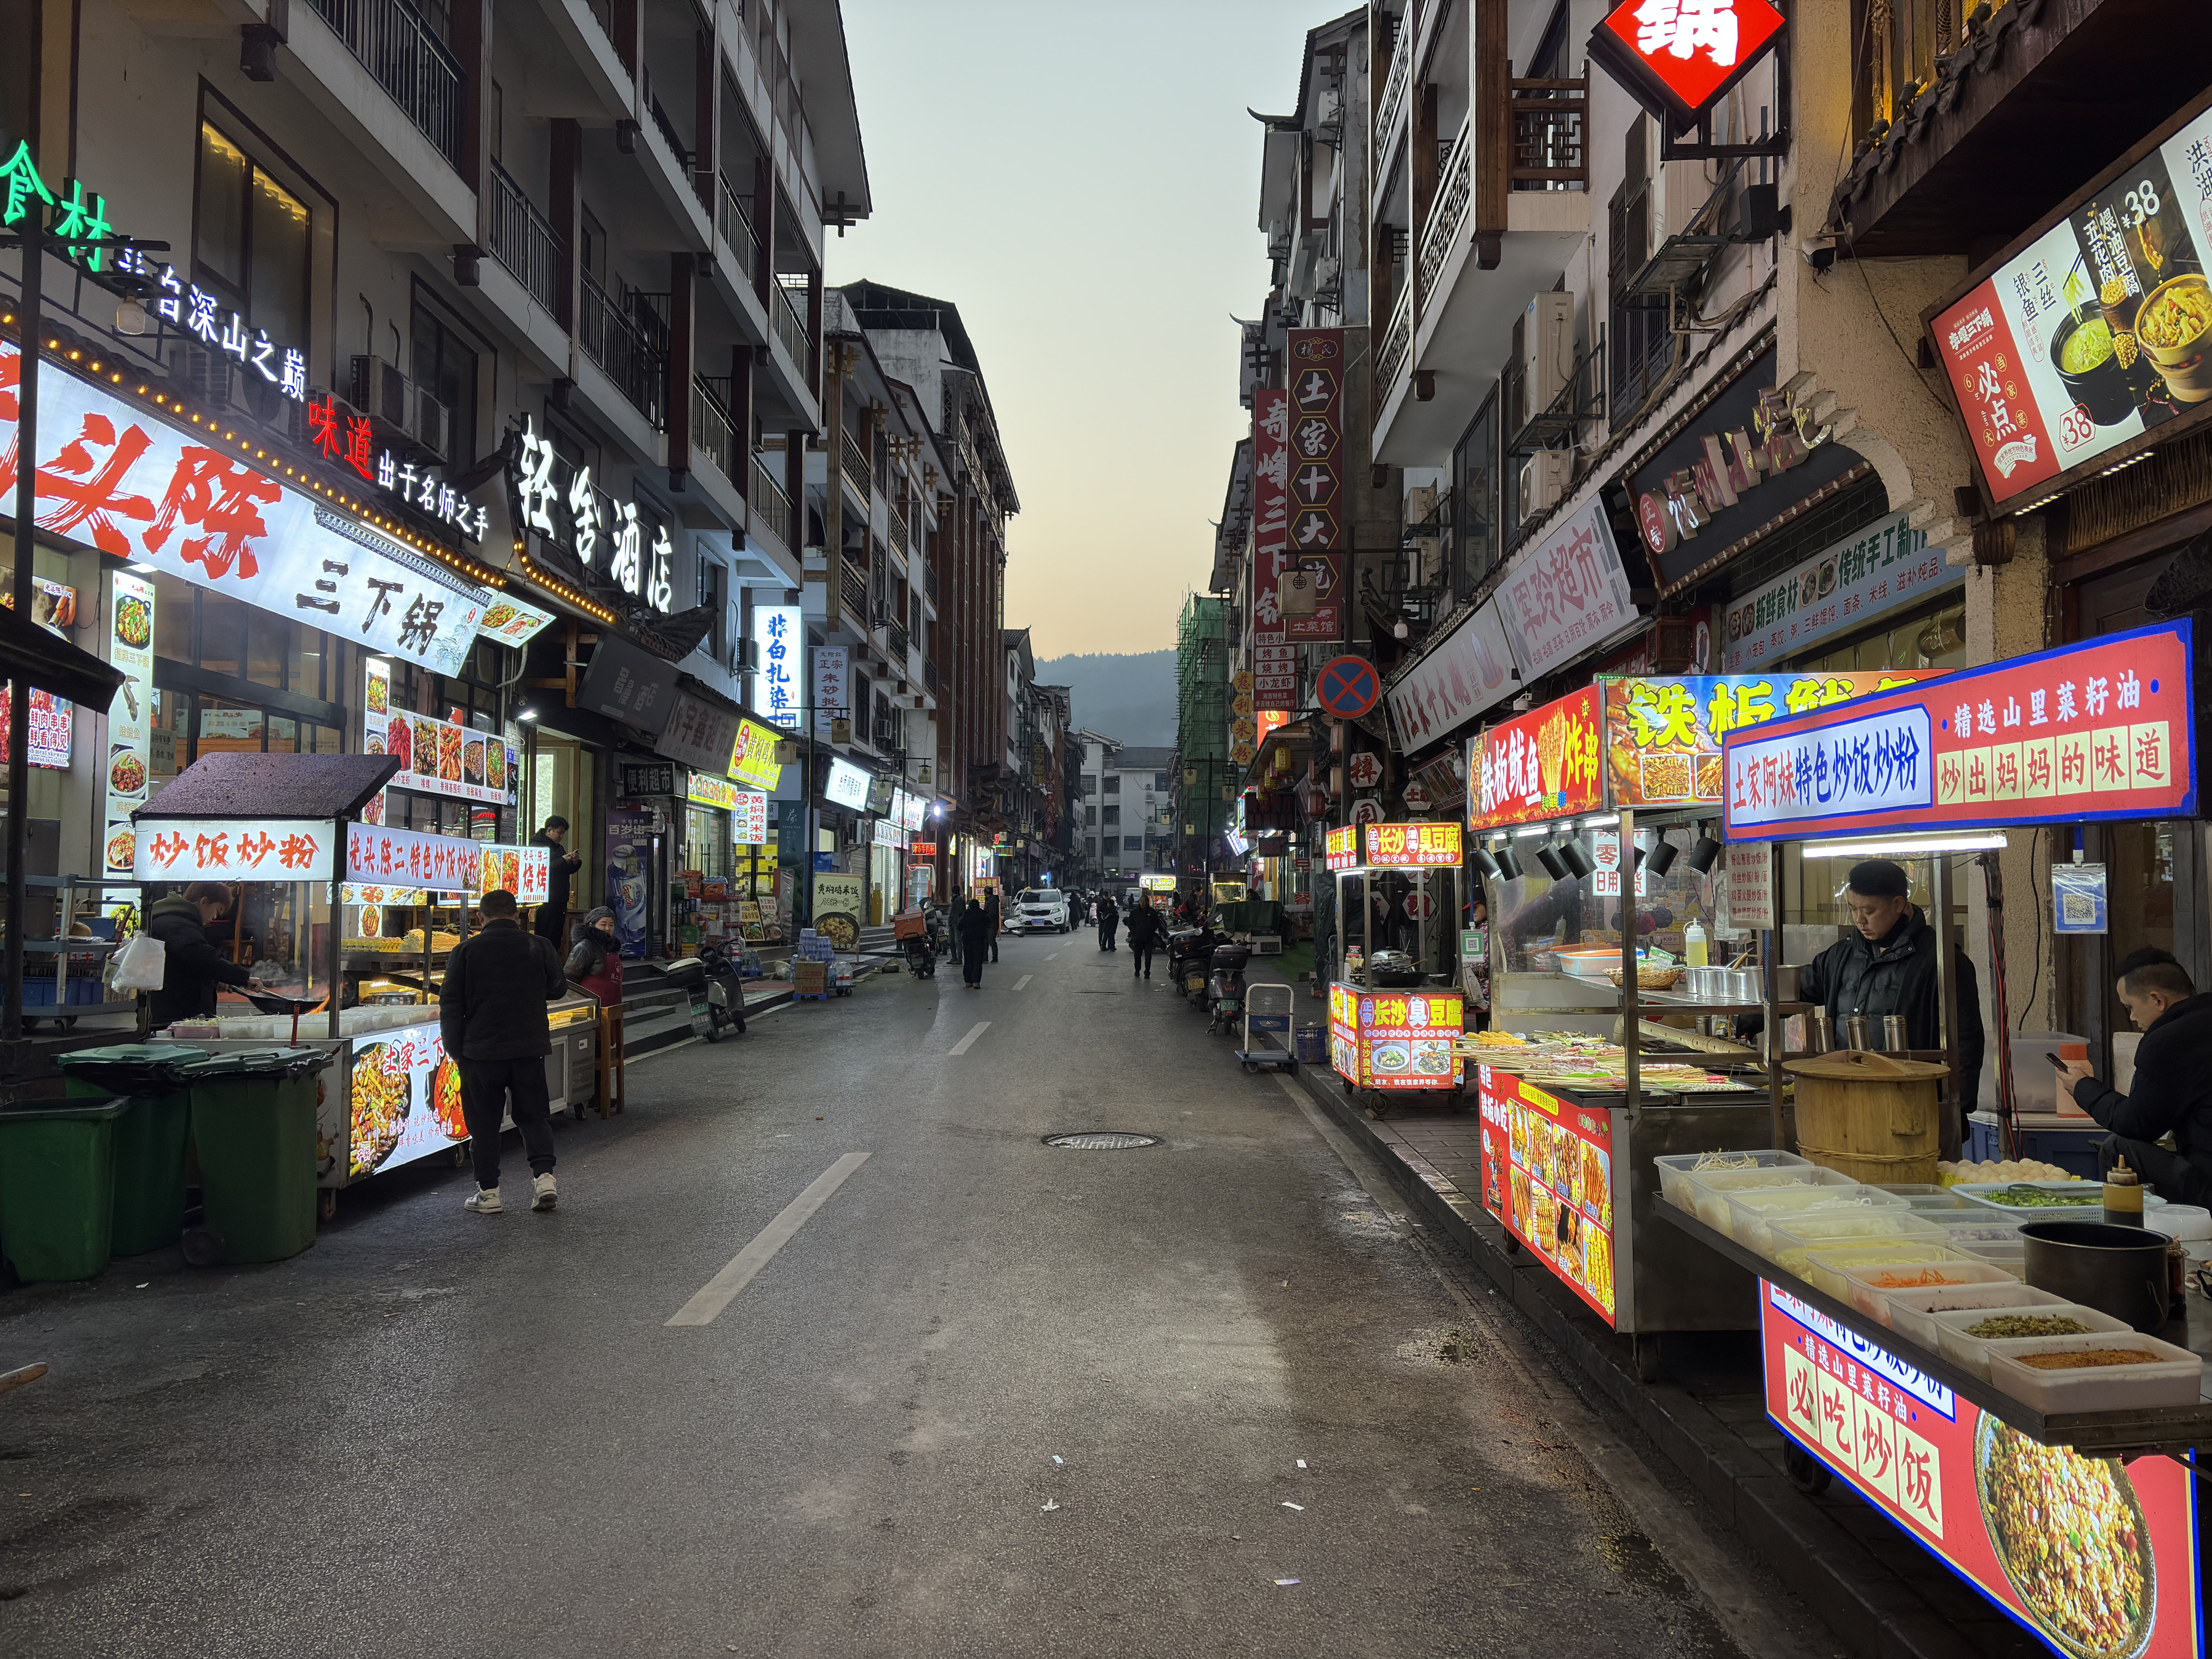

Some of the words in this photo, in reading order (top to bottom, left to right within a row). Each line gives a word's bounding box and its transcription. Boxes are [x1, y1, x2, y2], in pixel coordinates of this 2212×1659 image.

[2083, 220, 2115, 288] 五花肉
[2099, 207, 2140, 297] 煨油豆腐
[2013, 272, 2039, 322] 银鱼
[2032, 262, 2057, 311] 三丝
[0, 139, 112, 272] 食材
[309, 396, 373, 480] 味道
[378, 449, 489, 542] 出于名师之手
[1977, 361, 2017, 441] 必点
[0, 342, 282, 580] 头陈
[296, 559, 445, 656] 三下锅
[518, 414, 673, 613] 轻舍酒店
[1643, 500, 1663, 547] 正宗
[1564, 619, 1588, 644] 日用百货
[1585, 611, 1600, 631] 雨衣
[1599, 600, 1614, 622] 雨伞
[1756, 577, 1798, 631] 新鲜食材
[1258, 634, 1284, 644] 特色小
[1292, 622, 1334, 632] 土菜馆
[818, 660, 843, 669] 正宗
[1262, 648, 1288, 659] 烤鱼
[1262, 663, 1288, 674] 烧烤
[821, 674, 839, 719] 朱砂批发
[1259, 677, 1291, 688] 小龙虾
[29, 708, 69, 732] 鲜肉串串
[1234, 673, 1251, 761] 慈利米粉
[1954, 669, 2141, 738] 精选山里菜籽油
[29, 727, 69, 750] 鲜看得见
[119, 725, 140, 740] 娃娃鱼
[745, 732, 779, 769] 黄焖鸡米
[48, 750, 68, 759] skewers
[1481, 727, 1541, 813] 铁板鱿鱼
[1565, 713, 1599, 799] 炸串
[1734, 726, 1920, 812] 土家阿妹特色炒饭炒粉
[1941, 728, 2165, 800] 炒出妈妈的味道
[390, 774, 410, 786] 味小龙虾
[628, 768, 671, 792] 便利超市
[609, 825, 644, 834] 百岁山
[749, 796, 764, 842] 黄焖鸡米饭
[149, 831, 321, 871] 炒饭炒粉
[912, 843, 935, 854] 津市牛肉粉
[1370, 831, 1378, 851] 正宗
[1379, 827, 1405, 854] 长沙
[1419, 826, 1458, 854] 臭豆腐
[523, 863, 547, 893] 烧烤
[818, 884, 859, 895] 黄焖鸡米饭
[823, 898, 849, 907] 18元一份
[1363, 1001, 1372, 1023] 正宗
[1375, 999, 1406, 1026] 长沙
[1410, 999, 1427, 1026] 臭
[1429, 999, 1462, 1026] 豆腐
[383, 1036, 446, 1075] 土家三下
[1481, 1091, 1508, 1133] 铁板小吃
[1805, 1334, 1907, 1423] 精选山里菜籽油
[1790, 1366, 1939, 1523] 必吃炒饭
